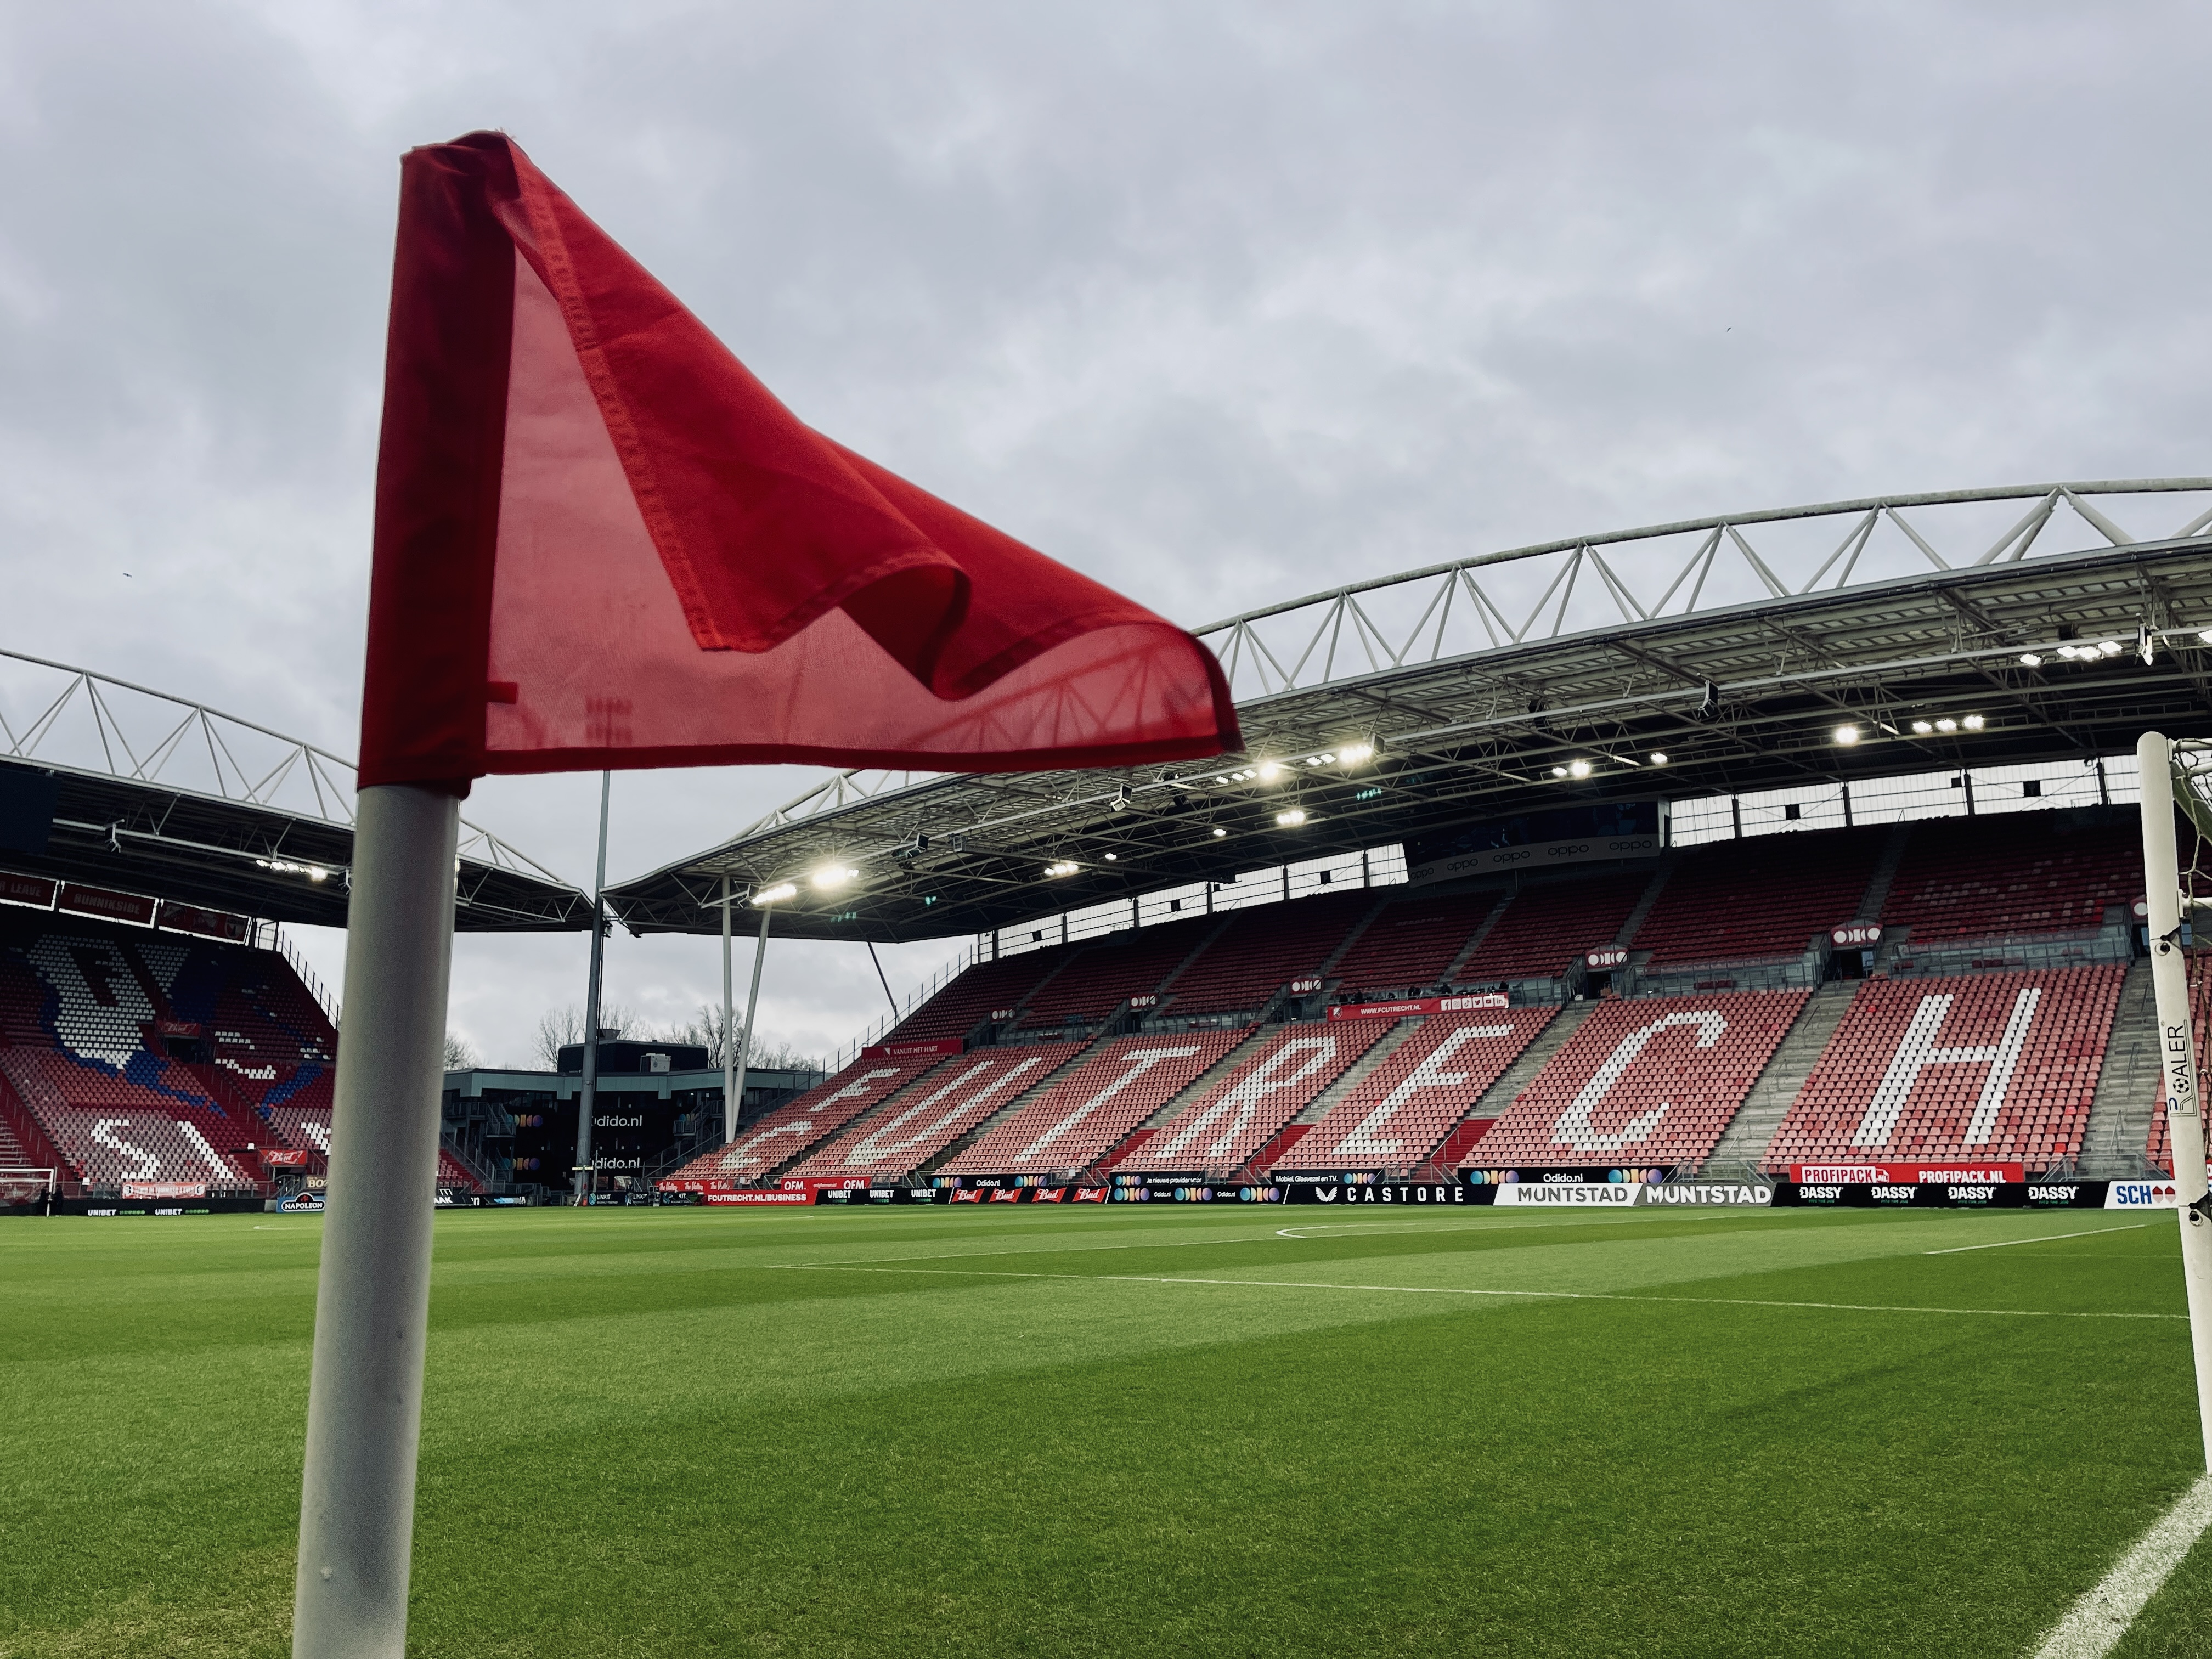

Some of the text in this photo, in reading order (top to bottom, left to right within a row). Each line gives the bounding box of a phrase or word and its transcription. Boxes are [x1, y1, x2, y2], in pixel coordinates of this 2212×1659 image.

[1548, 844, 1589, 856] oppo
[1609, 840, 1652, 851] oppo
[1493, 850, 1531, 864] oppo
[1447, 859, 1478, 872] oppo
[1410, 867, 1435, 881] oppo
[10, 882, 42, 897] LEAVE
[74, 893, 142, 915] BUNNIKSIDE
[1361, 1005, 1422, 1014] WWW.FCUTRECHT.NL
[893, 1047, 912, 1056] VANUIT
[590, 1157, 640, 1169] dido.nl
[1543, 1173, 1583, 1183] Odido.nl
[1804, 1169, 1872, 1183] PROFIPACK
[1918, 1170, 2007, 1183] PROFIPACK.NL
[707, 1193, 807, 1202] FCUTRECHT.NL/BUSINESS
[828, 1190, 851, 1198] UNIBET
[869, 1189, 894, 1198] UNIBET
[911, 1189, 936, 1198] UNIBET
[957, 1189, 977, 1200] Bud
[994, 1189, 1014, 1200] Bud
[1037, 1188, 1058, 1200] Bud
[1078, 1188, 1099, 1199] Bud
[1347, 1187, 1464, 1202] CASTORE
[1517, 1187, 1628, 1203] MUNTSTAD
[1646, 1185, 1771, 1204] MUNTSTAD
[285, 1201, 323, 1210] NAPOLEON
